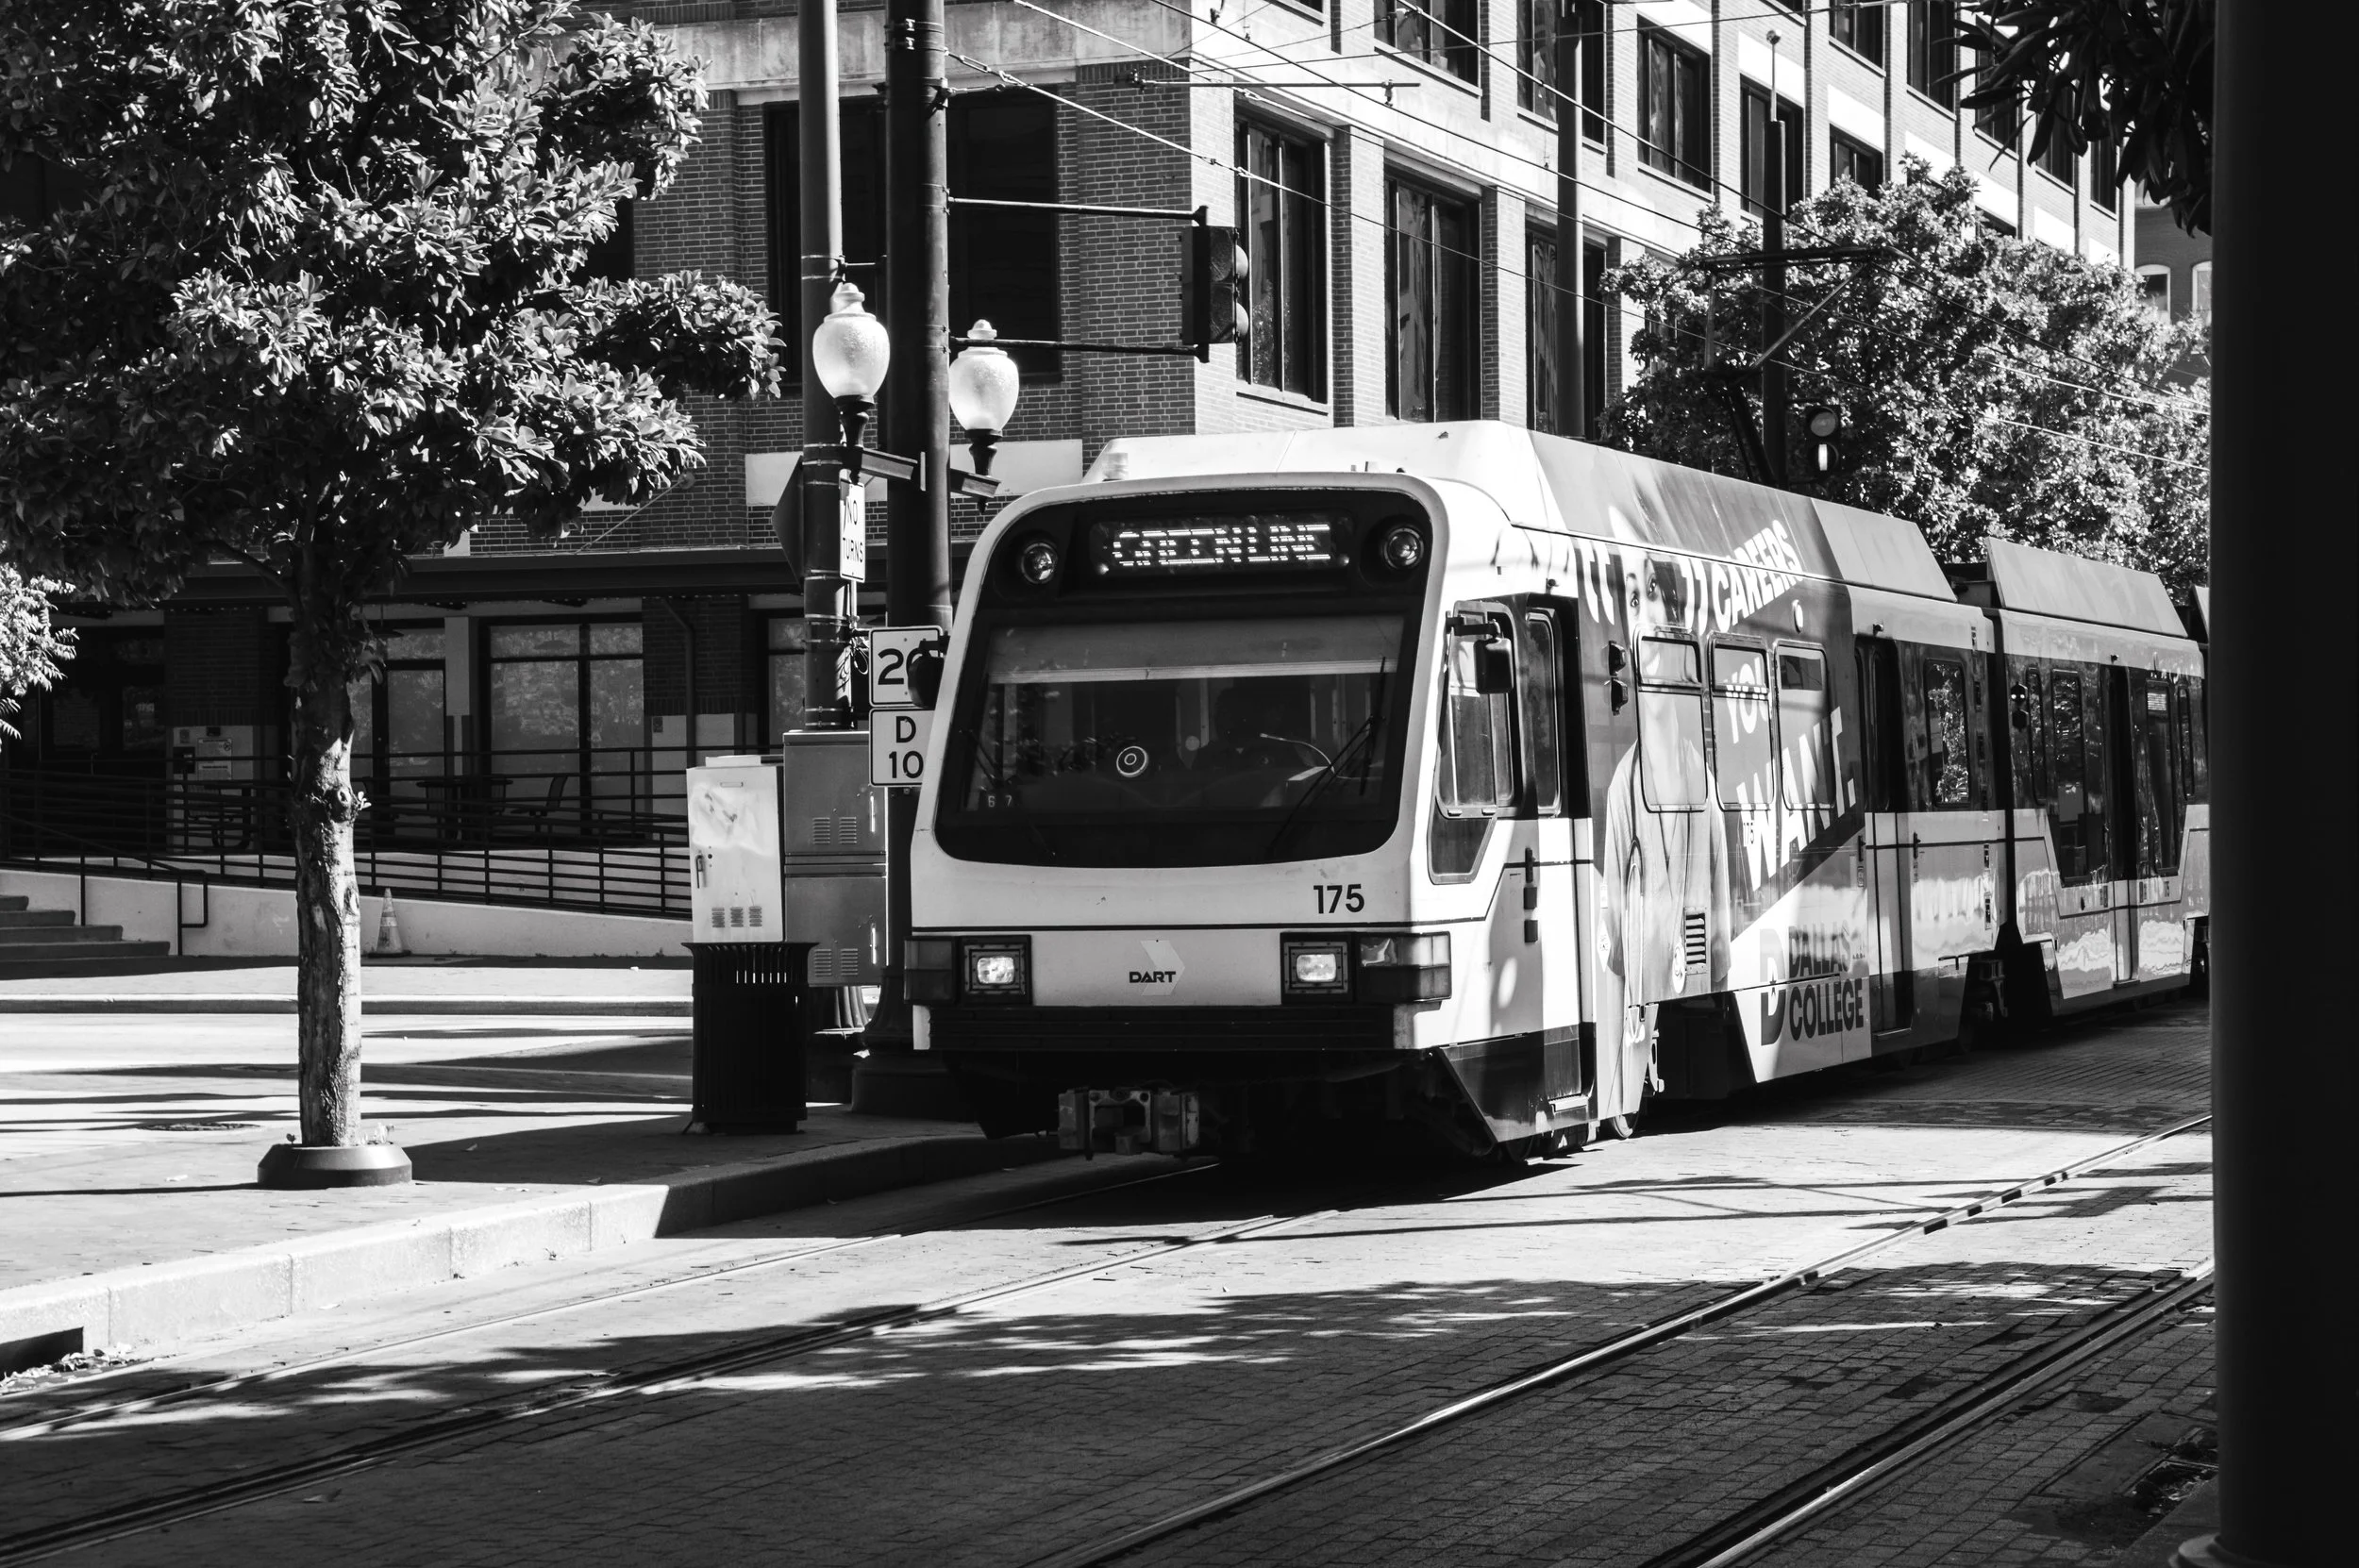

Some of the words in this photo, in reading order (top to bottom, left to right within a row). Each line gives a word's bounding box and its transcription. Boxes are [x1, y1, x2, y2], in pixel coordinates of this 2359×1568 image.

[845, 497, 858, 525] NO
[843, 537, 863, 563] TURNS
[1711, 519, 1804, 634] CAREERS
[1723, 655, 1772, 744] YOU
[895, 715, 917, 743] D
[888, 750, 925, 779] 10
[1313, 884, 1365, 914] 175
[1788, 920, 1851, 978] DALLAS
[1129, 971, 1177, 984] DART
[1789, 977, 1865, 1043] COLLEGE
